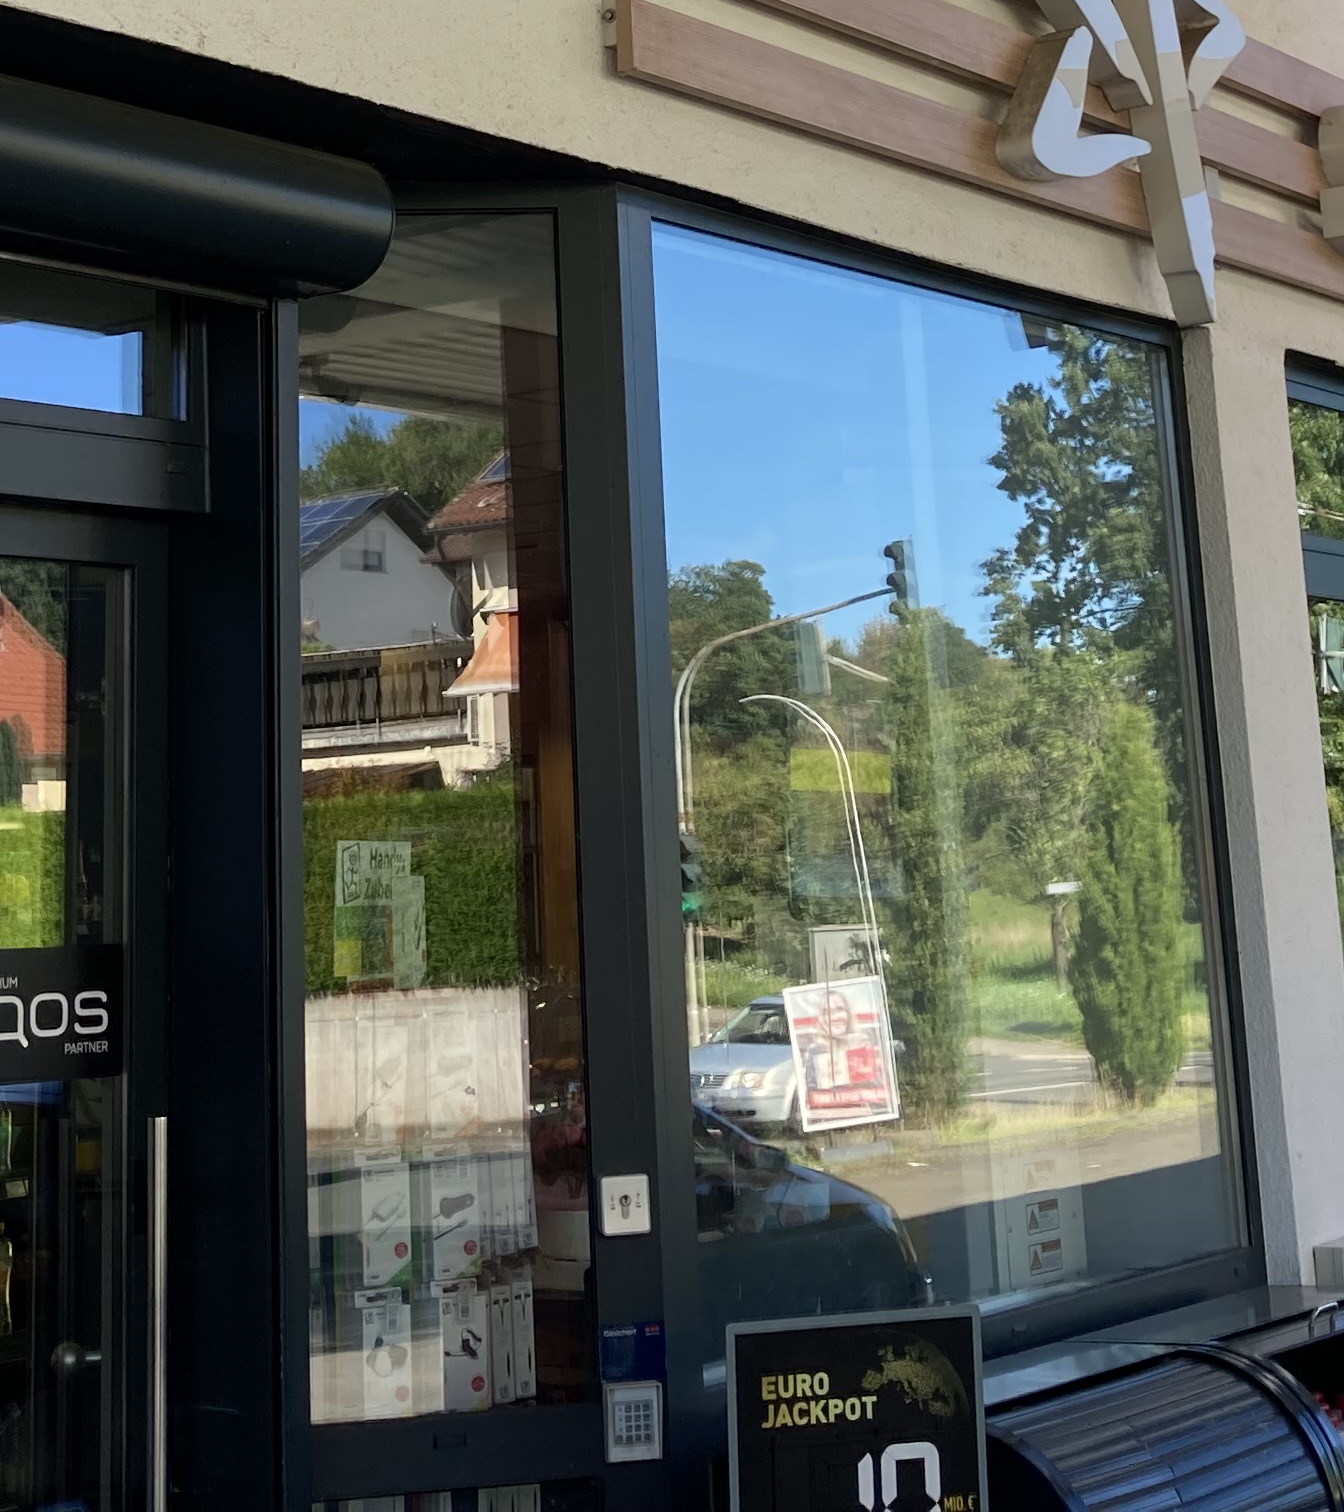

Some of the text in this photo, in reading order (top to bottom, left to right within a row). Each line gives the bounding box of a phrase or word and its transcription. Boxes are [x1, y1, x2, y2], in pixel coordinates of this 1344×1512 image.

[63, 1040, 109, 1055] PARTNER
[760, 1371, 830, 1401] EURO
[760, 1394, 878, 1430] JACKPOT
